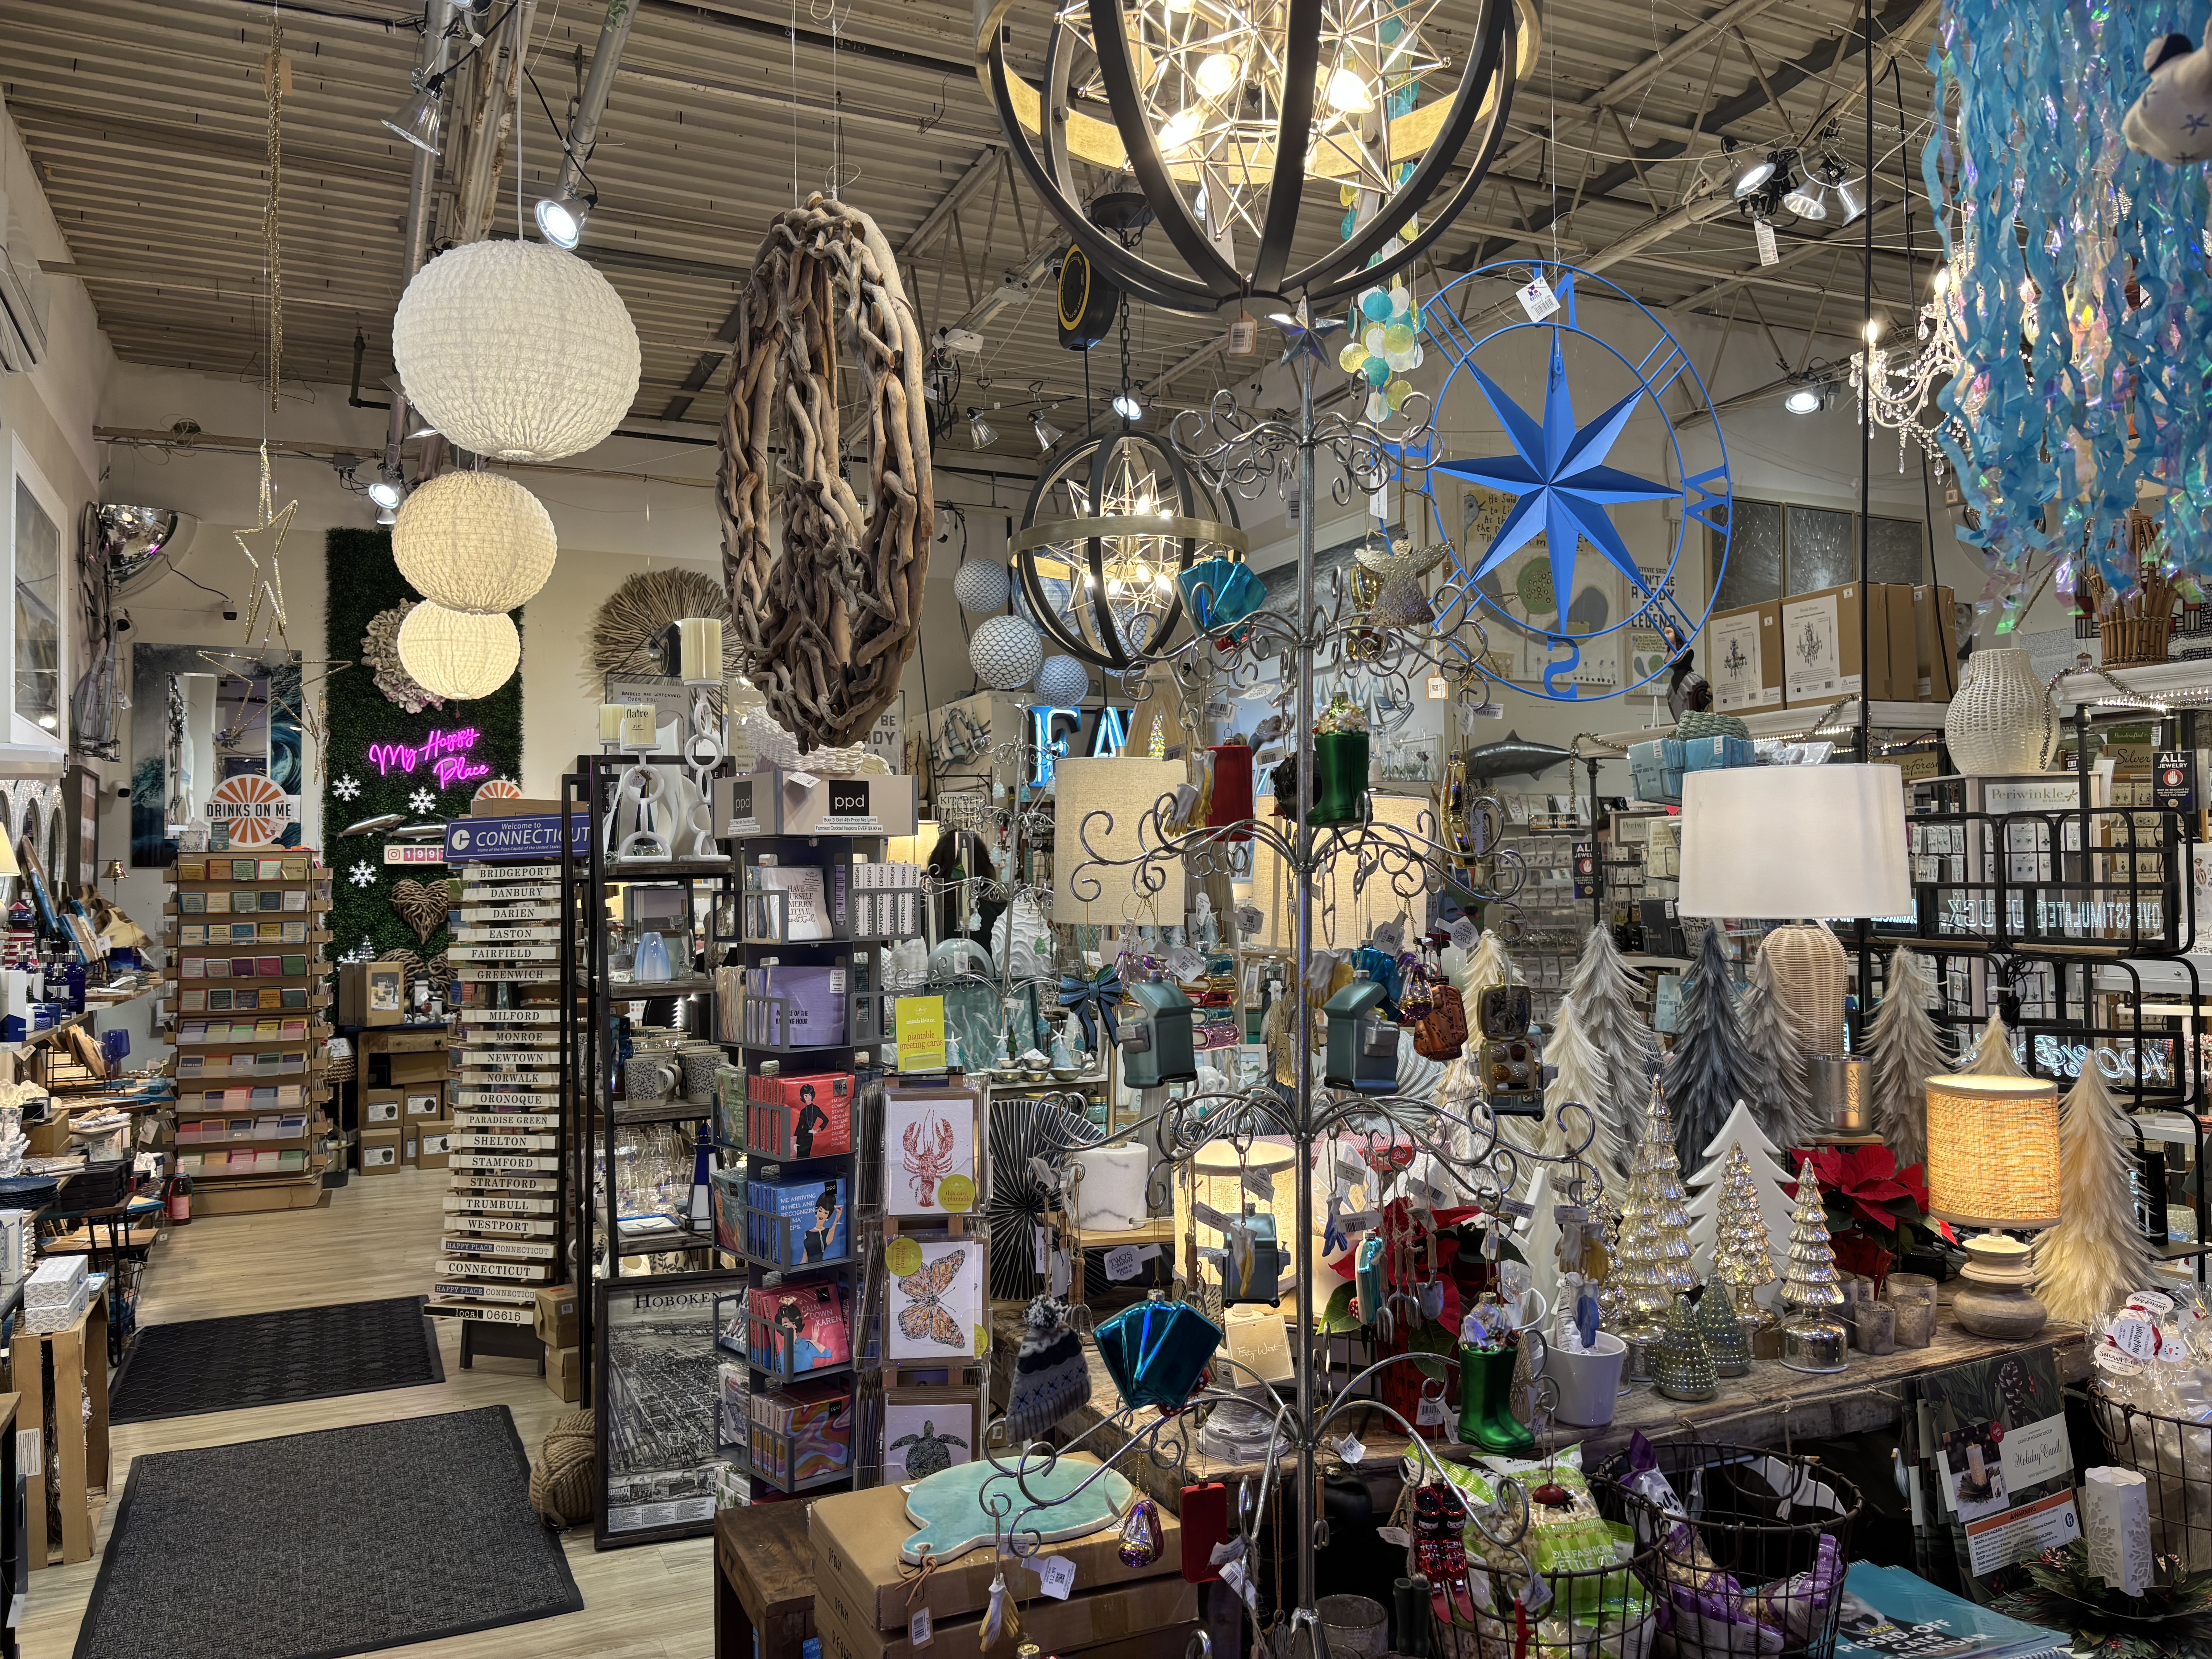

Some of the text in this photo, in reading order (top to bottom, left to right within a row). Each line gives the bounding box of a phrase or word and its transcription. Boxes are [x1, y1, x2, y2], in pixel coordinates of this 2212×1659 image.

[1489, 495, 1497, 503] He
[1476, 524, 1490, 532] the
[1664, 576, 1675, 586] BE
[1632, 586, 1638, 598] A
[881, 715, 896, 726] BE
[369, 728, 480, 775] My Happy
[2115, 748, 2152, 765] Silver
[2160, 754, 2185, 763] ALL
[433, 756, 489, 790] Place
[1992, 787, 2063, 800] Periwinkle
[736, 795, 750, 811] ppd
[835, 794, 864, 810] ppd
[207, 803, 292, 817] DRINKS ON ME
[480, 867, 551, 878] BRIDGEPORT
[491, 888, 543, 898] DANBURY
[493, 909, 534, 918] DARIEN
[489, 929, 532, 939] EASTON
[472, 949, 531, 958] FAIRFIELD
[1182, 955, 1196, 967] $12.99
[477, 970, 543, 979] GREENWICH
[489, 1012, 539, 1021] MILFORD
[496, 1032, 543, 1041] MONROE
[908, 1030, 934, 1042] plantable
[900, 1038, 943, 1052] greeting cards
[488, 1053, 543, 1063] NEWTOWN
[487, 1073, 539, 1083] NORWALK
[480, 1094, 541, 1105] ORONOQUE
[469, 1116, 548, 1125] PARADISE GREEN
[474, 1137, 527, 1146] SHELTON
[472, 1157, 533, 1168] STAMFORD
[471, 1178, 536, 1188] STRATFORD
[791, 1193, 816, 1202] ARRIVING
[467, 1199, 529, 1210] TRUMBULL
[781, 1207, 818, 1218] RECOGNIZING
[468, 1219, 529, 1231] WESTPORT
[447, 1242, 469, 1250] HAPPY
[496, 1245, 549, 1255] CONNECTICUT
[1109, 1251, 1132, 1265] TWO'S
[448, 1262, 531, 1276] CONNECTICUT
[486, 1288, 534, 1298] CONNECTICU
[634, 1291, 722, 1309] HOBOKEN
[2132, 1296, 2167, 1311] SNOWMAN
[802, 1303, 821, 1313] CALM
[455, 1308, 521, 1321] local 06615
[810, 1309, 833, 1320] DOWN
[816, 1315, 842, 1327] KAREN
[2132, 1324, 2145, 1355] SNOWMAN
[2014, 1449, 2041, 1468] Holiday
[1529, 1479, 1547, 1487] VEGAN
[2014, 1506, 2036, 1519] WARNING
[1551, 1523, 1571, 1533] SIMPLE
[1553, 1550, 1571, 1558] OLD
[1049, 1567, 1057, 1585] $12.99
[1865, 1624, 1896, 1635] 2026
[1835, 1619, 1953, 1653] PISSED-OFF
[1891, 1634, 1945, 1651] CATS
